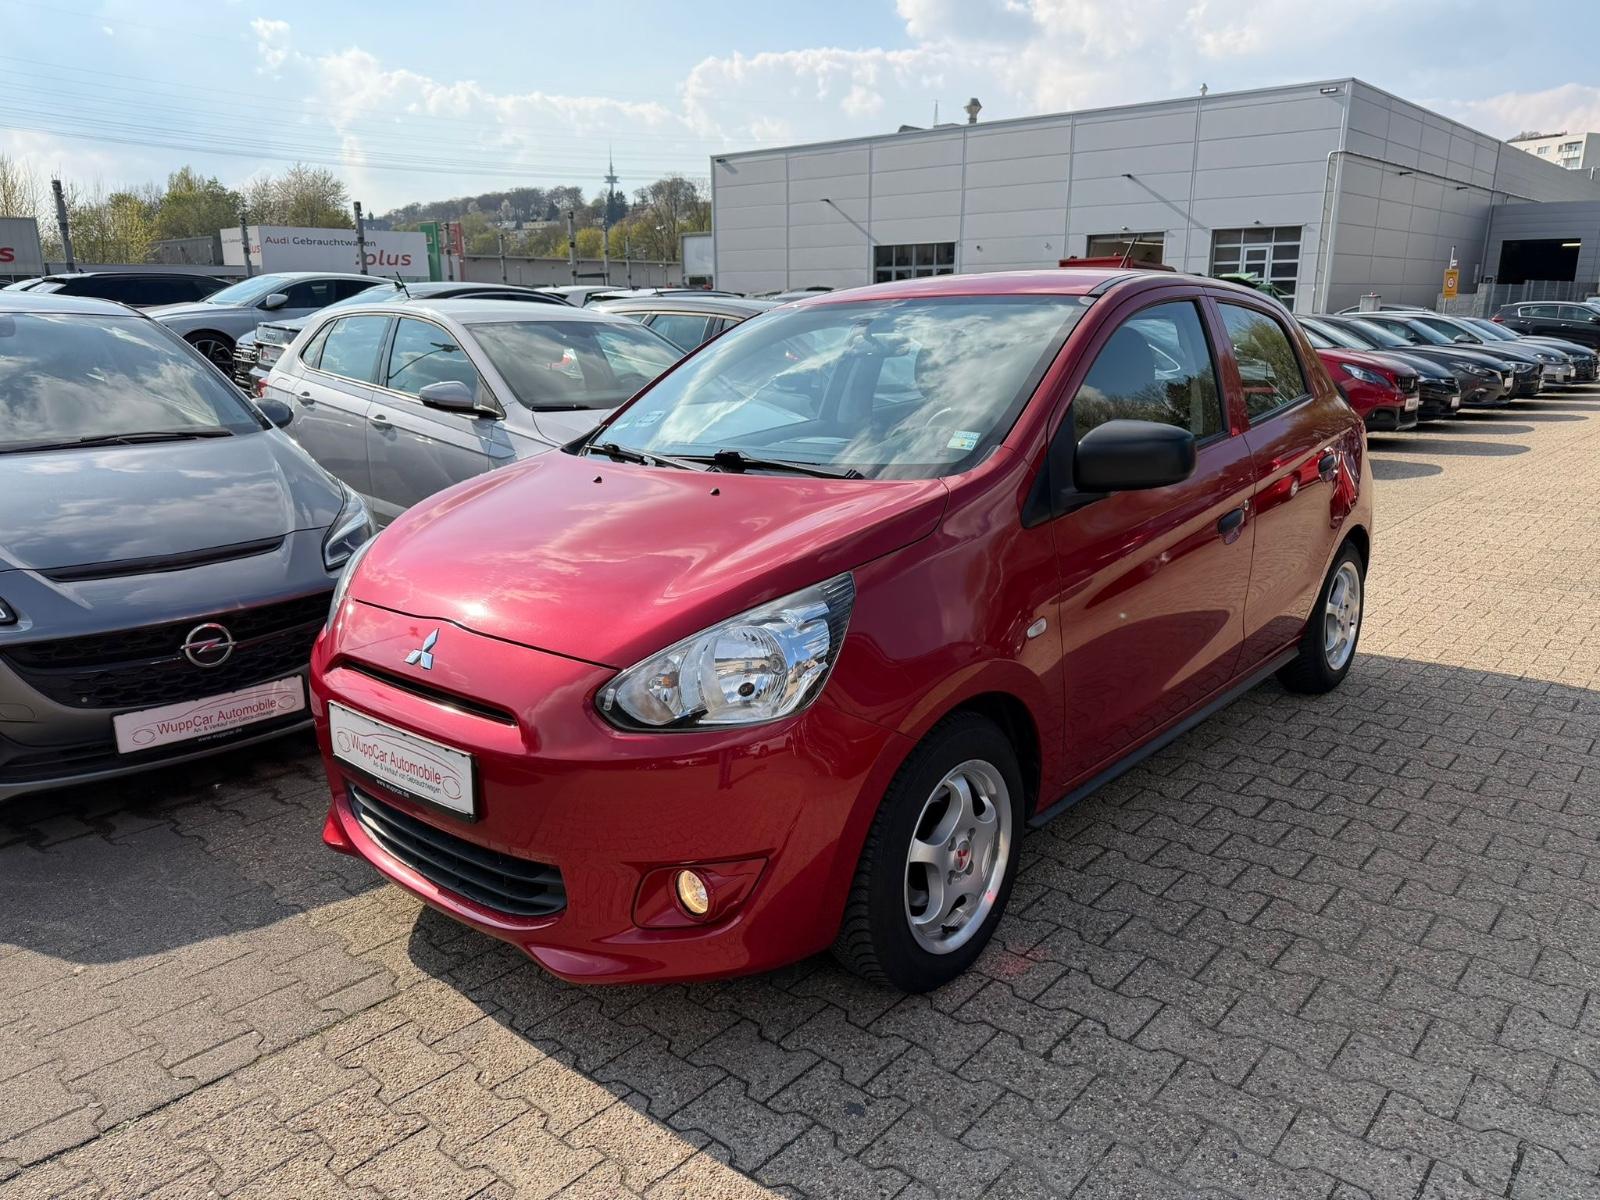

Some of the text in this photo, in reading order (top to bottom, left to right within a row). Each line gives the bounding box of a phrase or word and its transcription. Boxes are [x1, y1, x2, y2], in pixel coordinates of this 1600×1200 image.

[265, 235, 376, 248] Audi Gebrauchtwaen
[157, 698, 277, 736] WuppCar Automobile
[350, 734, 441, 785] WuppCar Automobile
